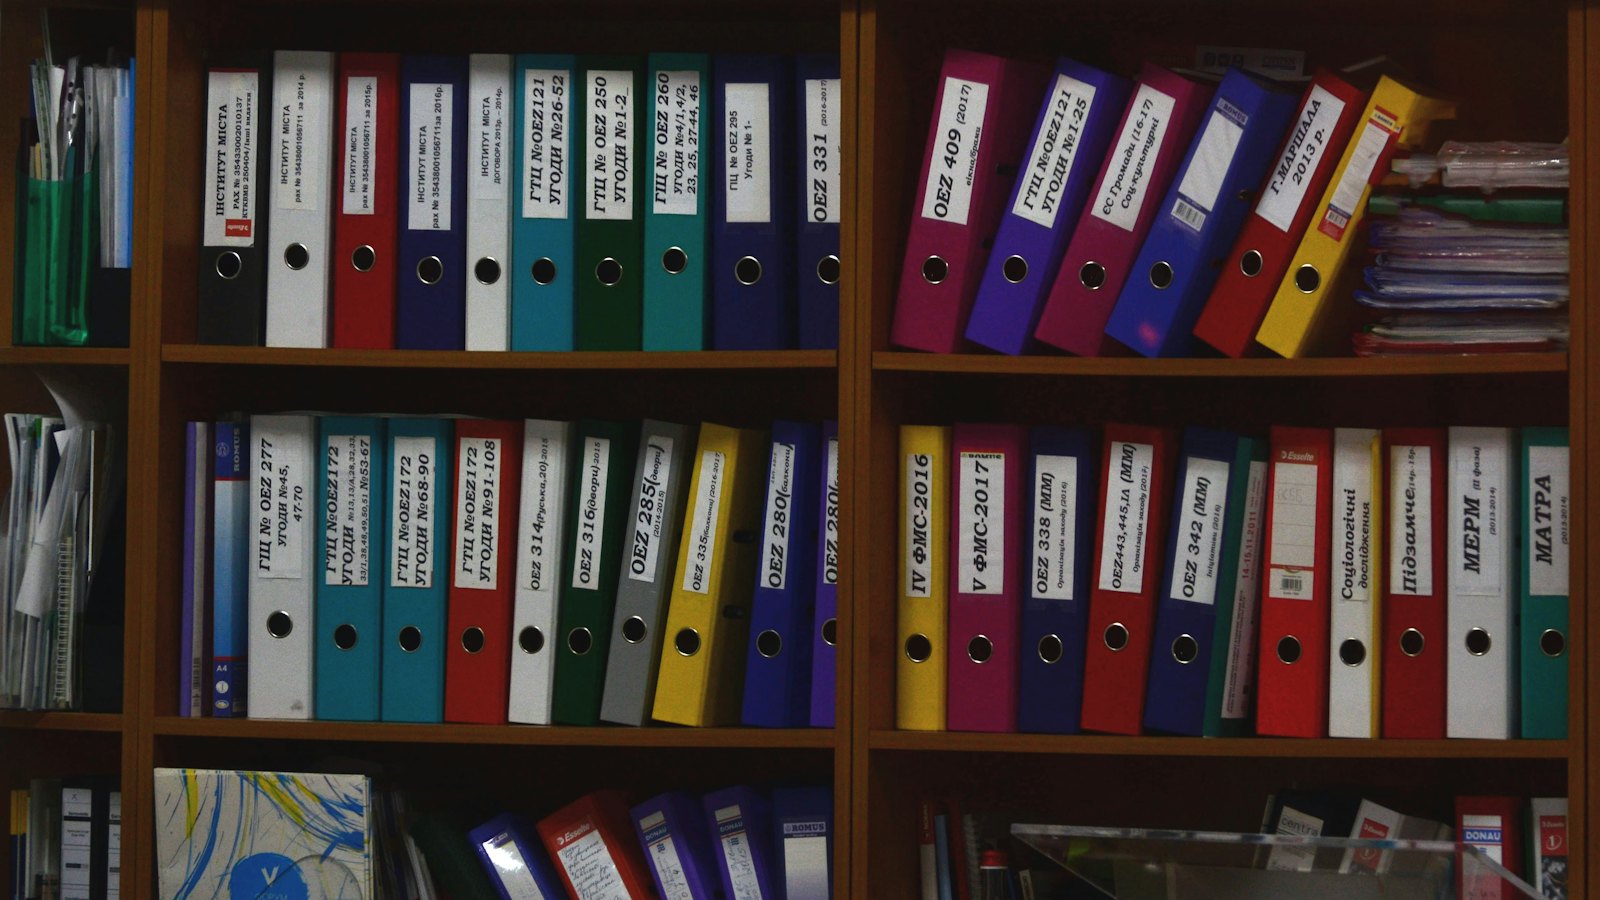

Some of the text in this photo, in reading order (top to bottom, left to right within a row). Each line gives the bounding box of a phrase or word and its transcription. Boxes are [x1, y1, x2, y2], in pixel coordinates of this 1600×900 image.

[364, 82, 372, 108] 2015р.
[365, 110, 370, 118] за
[434, 84, 444, 113] 2016р.
[481, 97, 490, 177] ІНСТИТУТ МІСТА
[550, 75, 564, 205] УГОДИ №26-52
[656, 72, 670, 170] № OEZ 260
[687, 84, 699, 194] 23, 25, 27-44, 46
[730, 110, 738, 168] № OEZ 295
[216, 104, 228, 216] ІНСТИТУТ МІСТА
[280, 105, 290, 184] ІНСТИТУТ МІСТА
[294, 178, 302, 188] №
[298, 102, 304, 110] за
[417, 126, 427, 203] ІНСТИТУТ МІСТА
[594, 76, 608, 213] ГТЦ № OEZ 250
[744, 120, 754, 179] Угоди № 1-
[814, 133, 828, 172] 331
[934, 84, 972, 218] OEZ 409 (2017)
[1041, 97, 1087, 214] УГОДИ №1-25
[1109, 142, 1136, 196] Громади
[1131, 98, 1154, 142] (16-17)
[1120, 117, 1160, 210] Соц-культурні
[1270, 100, 1322, 196] Г.МАРШАЛА
[1292, 128, 1325, 186] 2013 р.
[234, 178, 240, 188] №
[349, 154, 357, 193] ІНСТИТУТ
[362, 184, 368, 193] №
[530, 166, 543, 202] ГТЦ
[614, 144, 628, 203] УГОДИ
[674, 150, 684, 195] УГОДИ
[1023, 173, 1045, 210] ГТЦ
[432, 200, 439, 210] №
[432, 213, 440, 229] рах
[814, 178, 828, 222] OEZ
[360, 440, 369, 491] №53-67
[1287, 452, 1314, 462] Esselte
[1472, 446, 1482, 478] фаза)
[260, 438, 272, 536] № OEZ 277
[278, 465, 289, 547] УГОДИ №45,
[294, 486, 302, 522] 47-70
[416, 454, 429, 586] УГОДИ №68-90
[480, 440, 495, 582] УГОДИ №91-108
[653, 490, 666, 538] (2014-2015)
[912, 454, 928, 594] IV ФМС-2016
[973, 460, 988, 572] ФМС-2017
[1059, 508, 1067, 536] заходу
[1132, 523, 1143, 573] Організація
[1138, 492, 1147, 521] заходу
[1212, 504, 1222, 530] (2016)
[1534, 474, 1552, 566] МАТРА
[326, 536, 338, 574] ГТЦ
[342, 525, 355, 585] УГОДИ
[462, 536, 474, 574] ГТЦ
[631, 530, 650, 575] OEZ
[1038, 516, 1050, 552] 338
[1188, 520, 1202, 556] 342
[1341, 488, 1356, 600] Соціологічні
[1358, 502, 1370, 589] дослідження
[397, 546, 410, 583] ГТЦ
[530, 560, 541, 590] OEZ
[579, 548, 592, 584] OEZ
[692, 564, 704, 591] OEZ
[768, 543, 784, 588] OEZ
[973, 578, 987, 592] V
[1036, 556, 1048, 594] OEZ
[1057, 539, 1066, 590] Організація
[1182, 560, 1198, 598] OEZ
[564, 823, 590, 842] Esselte
[644, 826, 668, 841] DONAU
[720, 820, 743, 833] DONAU
[792, 823, 824, 832] ROMUS
[1281, 816, 1320, 836] centra
[1466, 832, 1502, 840] DONAU
